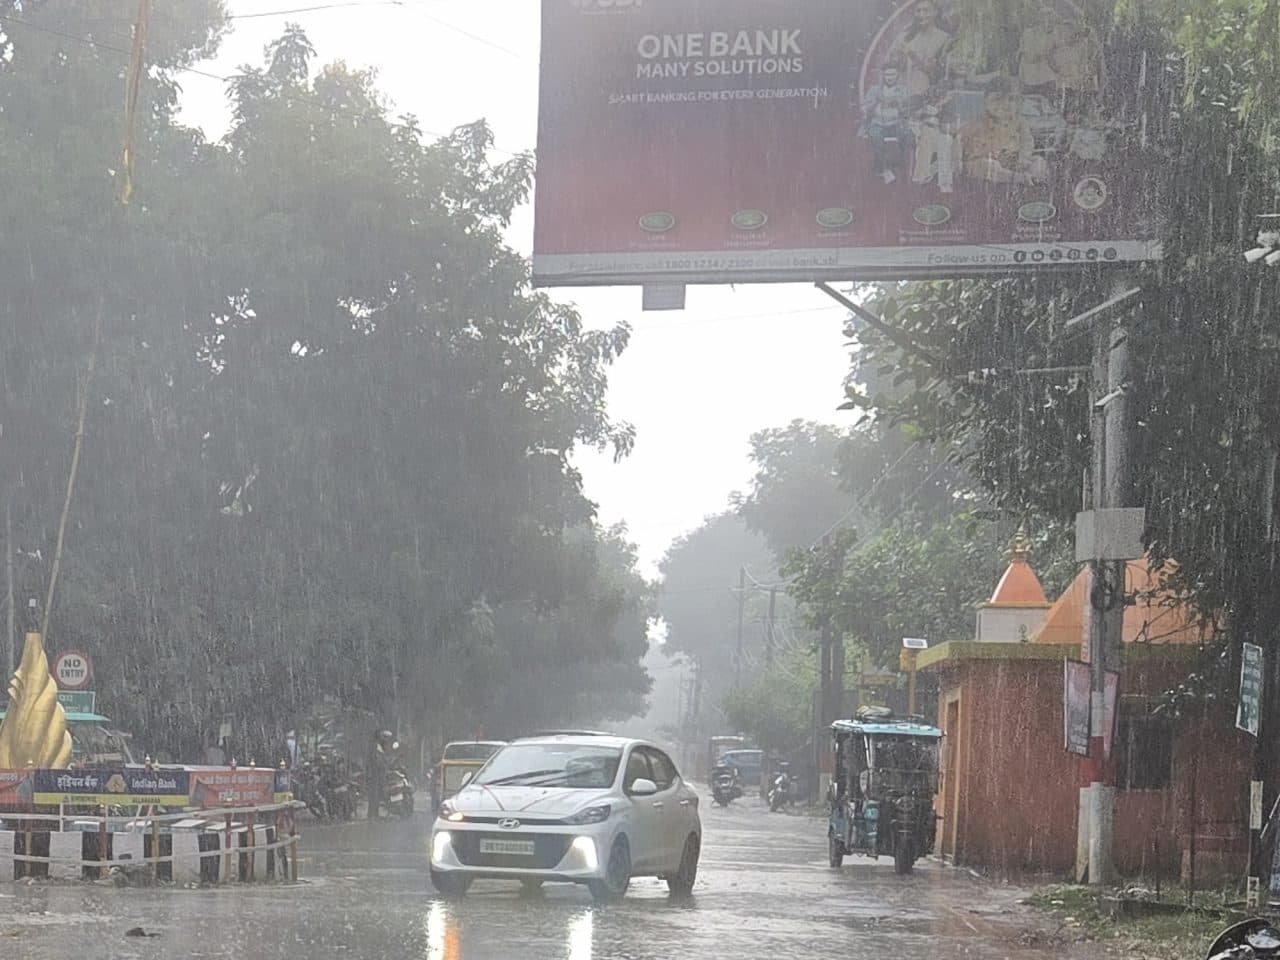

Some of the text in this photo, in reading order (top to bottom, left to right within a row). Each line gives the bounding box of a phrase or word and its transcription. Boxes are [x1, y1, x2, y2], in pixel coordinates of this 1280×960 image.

[637, 29, 802, 59] ONE BANK
[636, 57, 803, 79] MANY SOLUTIONS
[647, 91, 696, 103] BANKING
[757, 86, 828, 99] GENERATION
[64, 659, 81, 668] NO
[60, 669, 84, 678] ENTRY
[132, 778, 177, 789] Indian Bank
